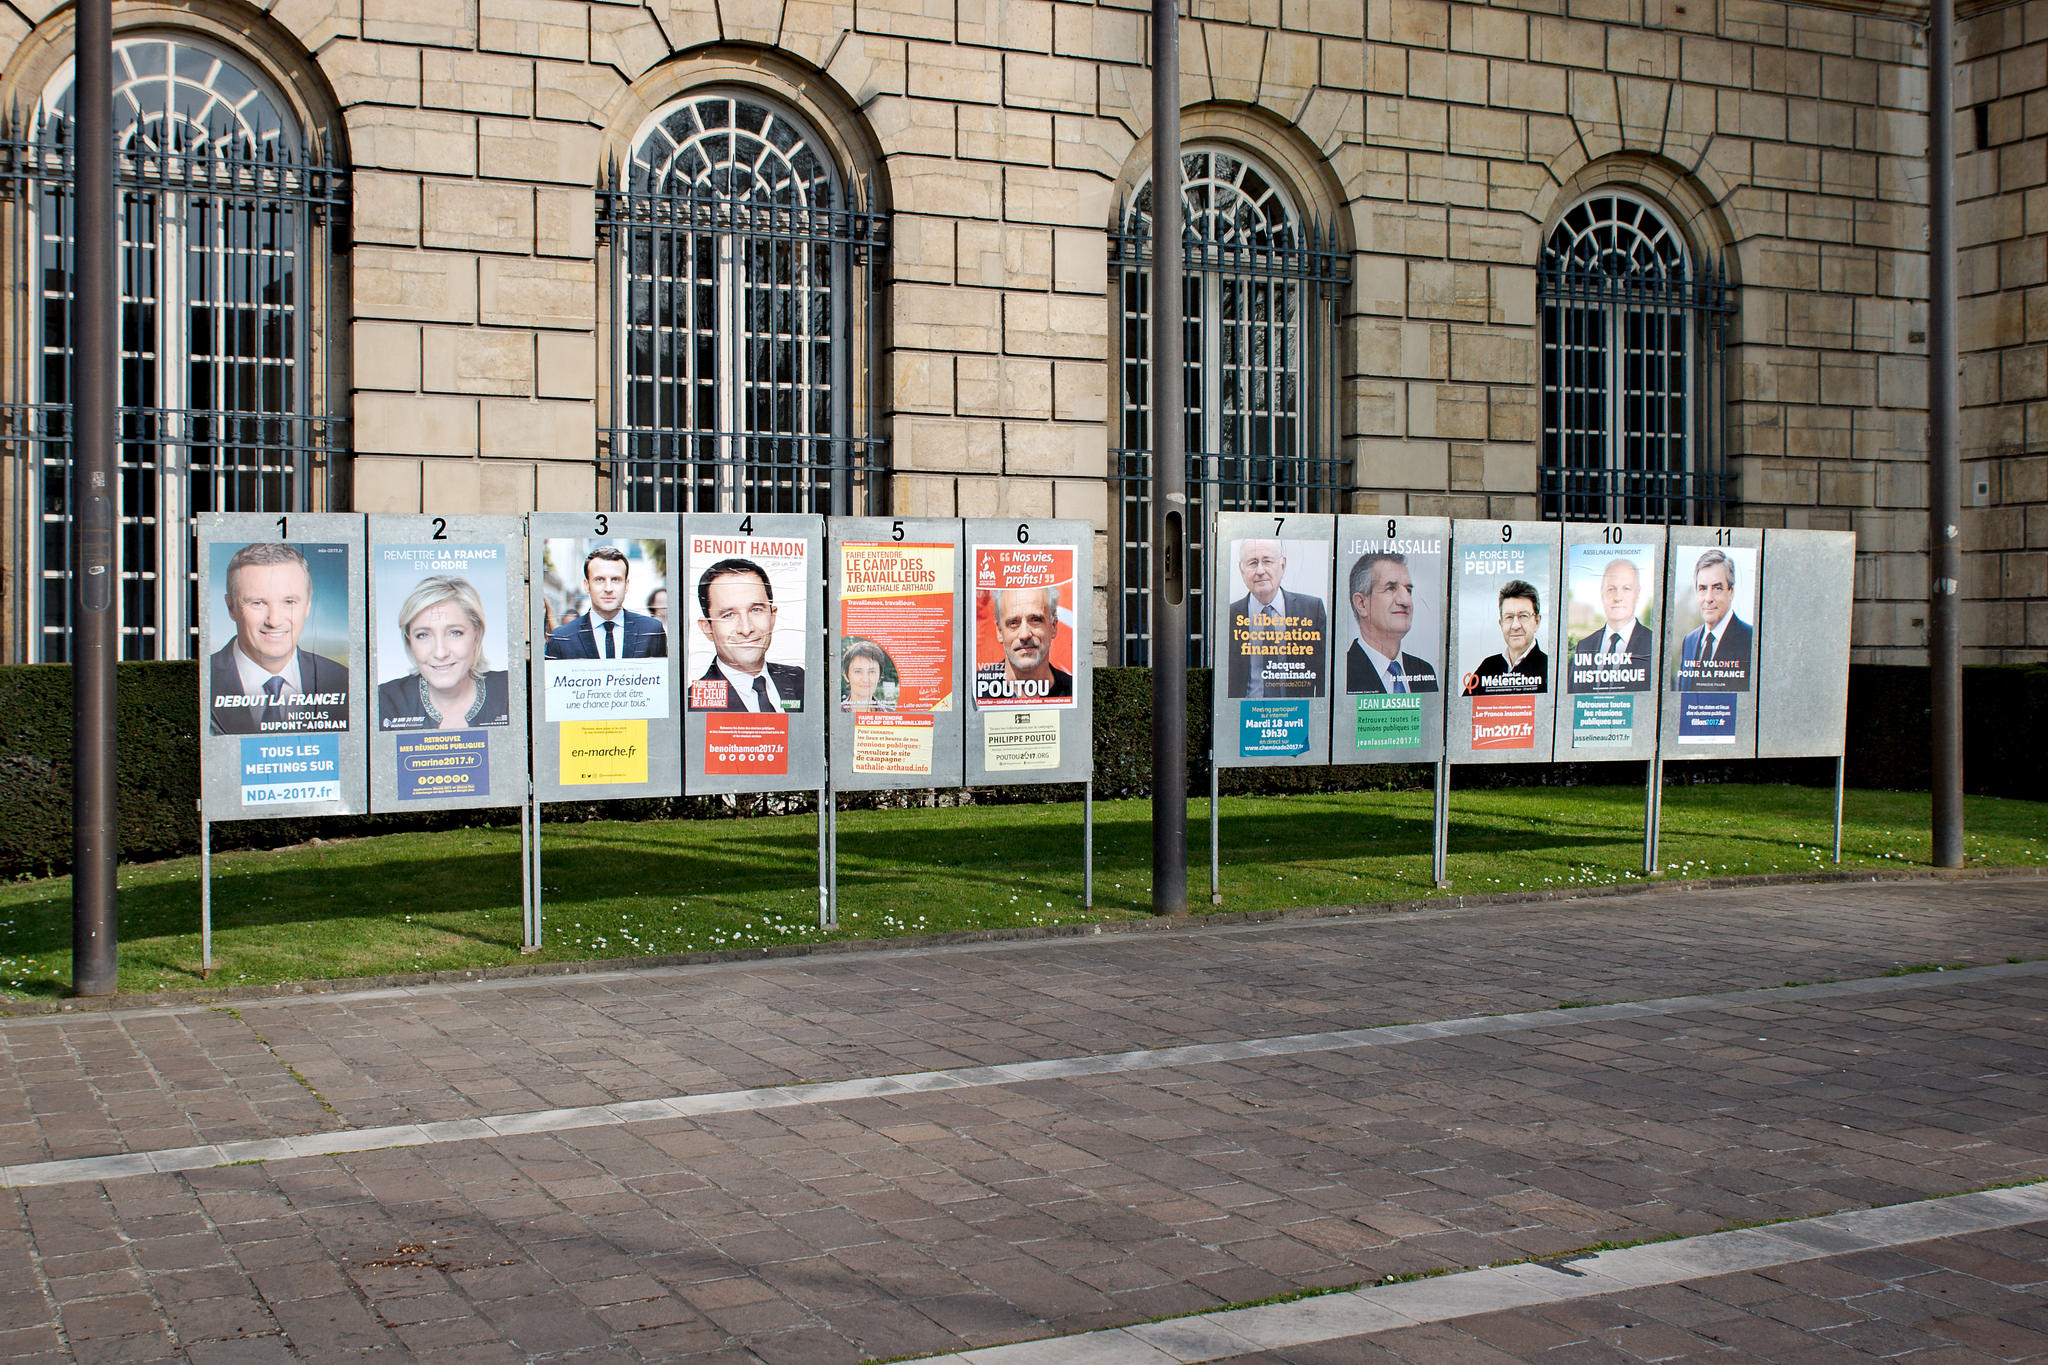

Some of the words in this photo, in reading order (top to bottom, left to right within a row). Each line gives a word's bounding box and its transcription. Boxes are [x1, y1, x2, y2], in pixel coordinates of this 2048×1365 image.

[277, 517, 287, 539] 1
[432, 518, 447, 540] 2
[594, 514, 608, 535] 3
[739, 516, 753, 536] 4
[1274, 518, 1285, 536] 7
[1387, 520, 1396, 538] 8
[892, 521, 904, 541] 5
[1017, 524, 1029, 543] 6
[1502, 524, 1512, 542] 9
[1603, 526, 1622, 544] 10
[1716, 529, 1730, 546] 11
[694, 540, 746, 554] BENOIT
[751, 542, 804, 556] HAMON
[1348, 540, 1378, 554] JEAN
[1383, 540, 1440, 554] LASSALLE
[384, 551, 434, 560] REMETTRE
[438, 550, 451, 559] LA
[455, 550, 496, 559] FRANCE
[1012, 552, 1031, 561] Nos
[1033, 552, 1054, 563] vies,
[1480, 551, 1508, 559] FORCE
[415, 561, 428, 570] EN
[432, 561, 468, 569] ORDRE
[847, 560, 860, 570] LE
[864, 559, 897, 570] CAMP
[901, 559, 923, 570] DES
[1004, 565, 1021, 575] pas
[1023, 563, 1047, 573] leurs
[1465, 561, 1524, 575] PEUPLE
[847, 571, 935, 583] TRAVAILLEURS
[979, 571, 996, 579] NPA
[867, 584, 899, 592] NATHALIE
[1236, 615, 1250, 626] Se
[1253, 614, 1299, 626] libérer
[1301, 617, 1312, 626] de
[1241, 643, 1314, 655] financière
[1574, 653, 1592, 666] UN
[1594, 653, 1632, 665] CHOIX
[1266, 661, 1305, 671] Jacques
[554, 676, 601, 687] Macron
[606, 674, 660, 686] Président
[1261, 670, 1316, 679] Cheminade
[1482, 674, 1542, 686] Mélenchon
[1574, 669, 1645, 683] HISTORIQUE
[587, 690, 611, 699] France
[614, 689, 627, 698] doit
[629, 689, 643, 697] être
[694, 689, 704, 699] LE
[704, 689, 727, 699] CŒUR
[978, 680, 1049, 697] POUTOU
[215, 695, 268, 707] DEBOUT
[269, 694, 286, 706] LA
[611, 701, 628, 710] pour
[1359, 699, 1378, 709] JEAN
[1382, 698, 1420, 708] LASSALLE
[288, 712, 328, 720] NICOLAS
[1580, 718, 1611, 726] publiques
[260, 720, 346, 731] DUPONT-AIGNAN
[1246, 720, 1270, 728] Mardi
[1272, 719, 1282, 727] 18
[1284, 719, 1303, 727] avril
[1026, 734, 1056, 742] POUTOU
[1261, 729, 1288, 737] 19h30
[1473, 723, 1533, 741] jlm2017.fr
[450, 742, 485, 750] PUBLIQUES
[1358, 737, 1420, 747] jeanlassalle2017.fr
[260, 747, 293, 758] TOUS
[296, 745, 320, 756] LES
[572, 746, 636, 758] en-marche.fr
[246, 762, 308, 774] MEETINGS
[310, 761, 334, 771] SUR
[412, 756, 474, 767] marine2017.fr
[856, 763, 928, 771] nathalie-arthaud.info
[247, 787, 332, 801] NDA-2017.fr
